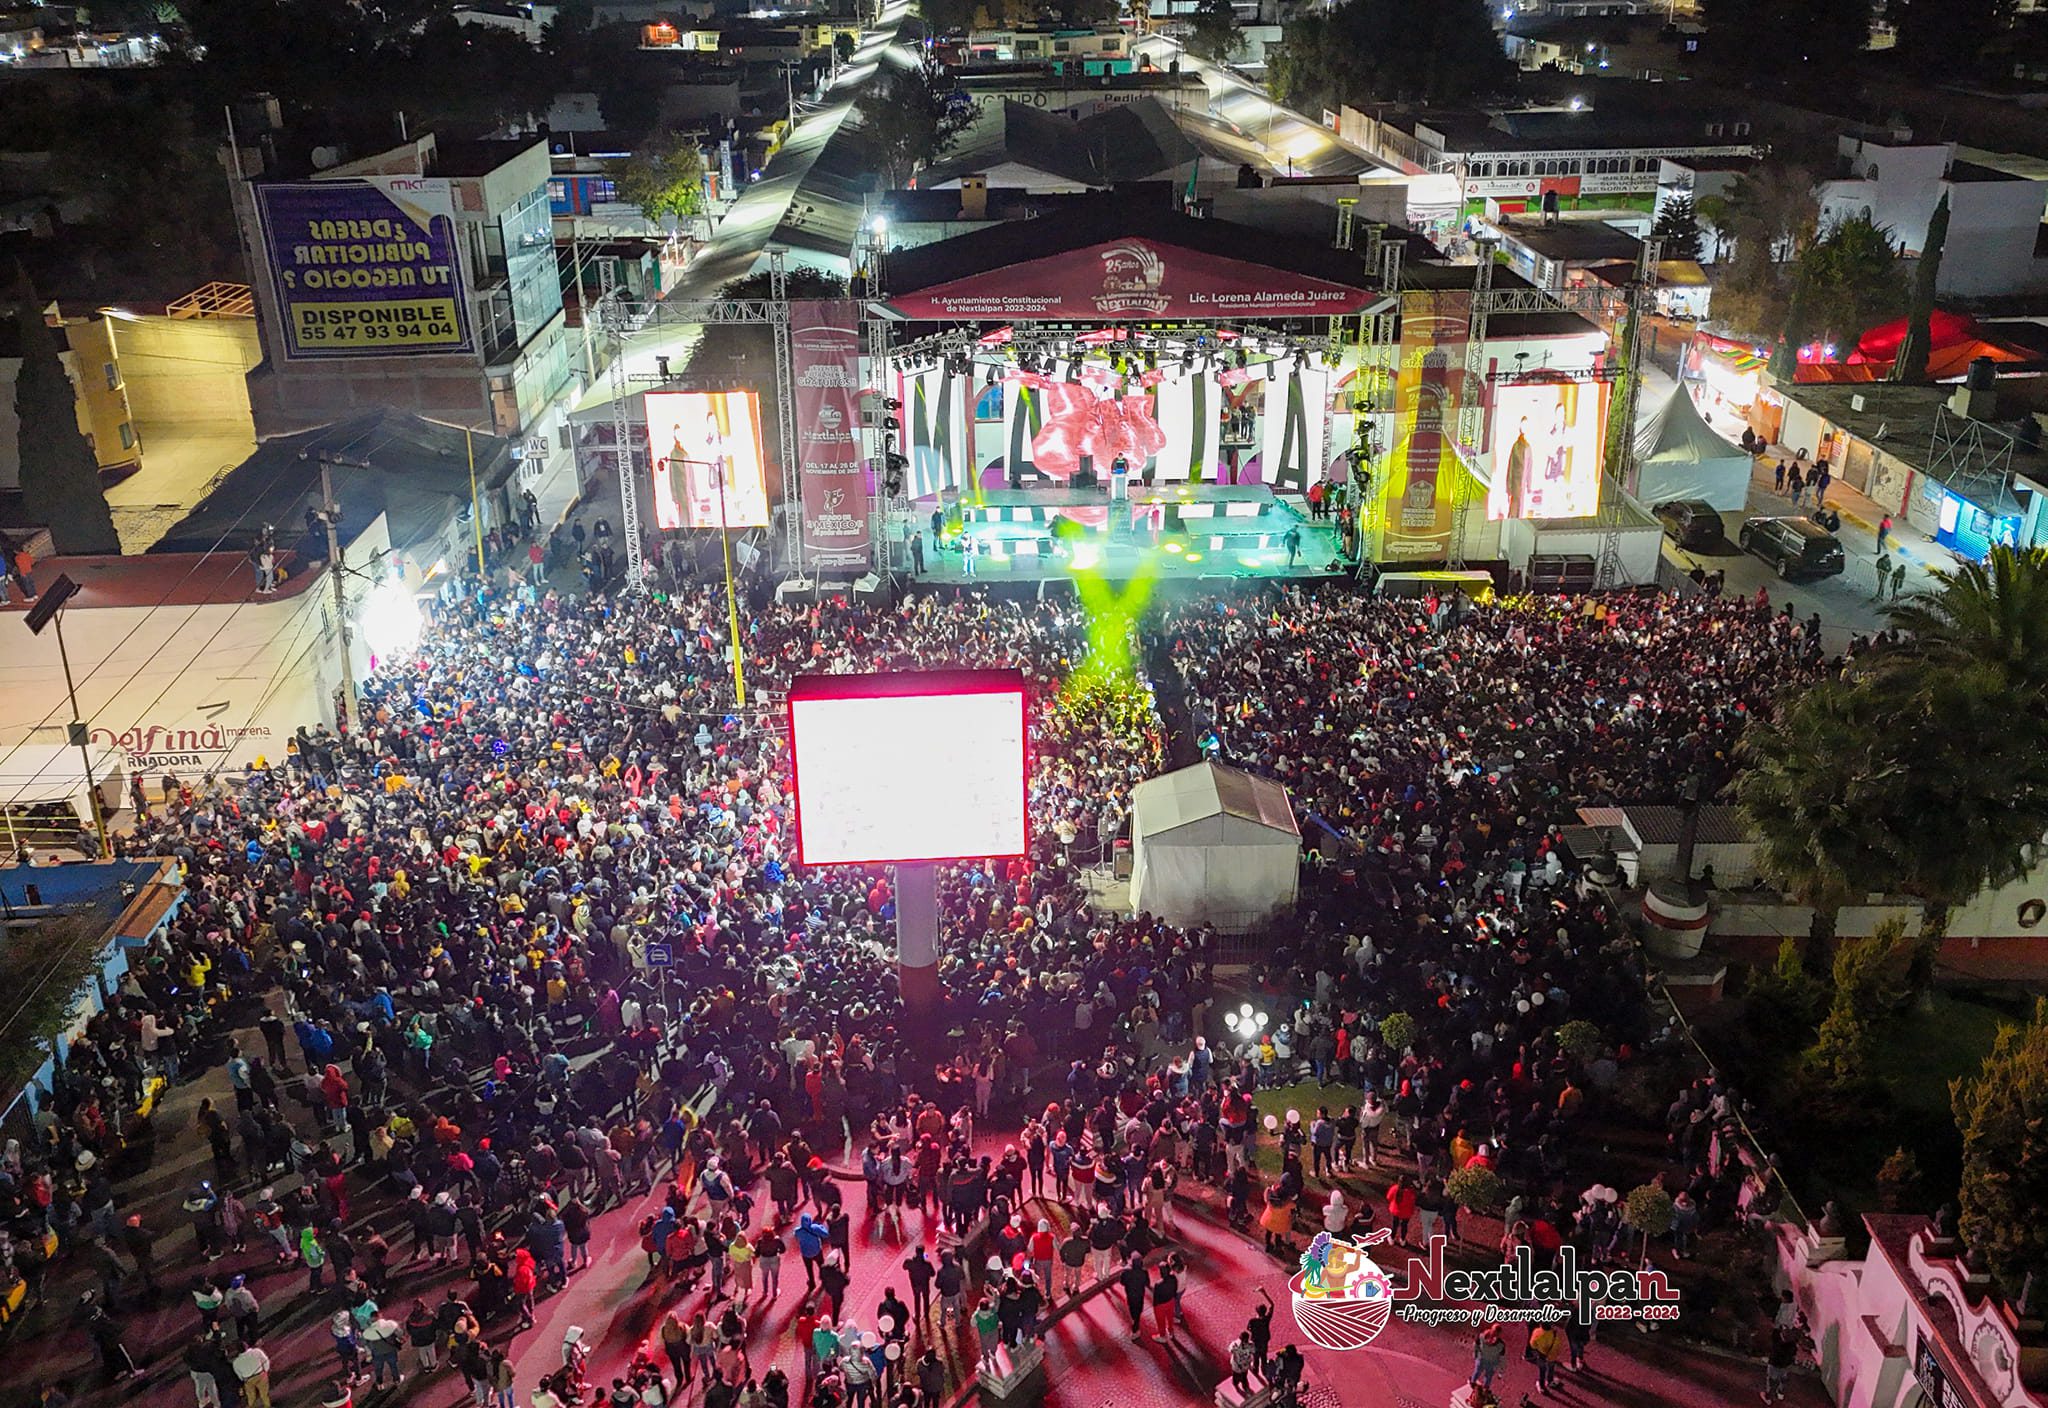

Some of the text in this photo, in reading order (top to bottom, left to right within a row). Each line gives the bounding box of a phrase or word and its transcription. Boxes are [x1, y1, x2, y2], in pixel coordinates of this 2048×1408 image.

[931, 295, 1062, 305] H. Ayuntamiento Constitucional
[1189, 289, 1346, 303] Lic. Lorena Alameda Juárez
[959, 304, 1003, 313] Nextlalpan
[1004, 304, 1047, 312] 2022-2024
[302, 306, 447, 325] DISPONIBLE
[302, 322, 454, 340] 55 47 93 94 04
[529, 439, 547, 450] WC
[226, 726, 272, 737] morena
